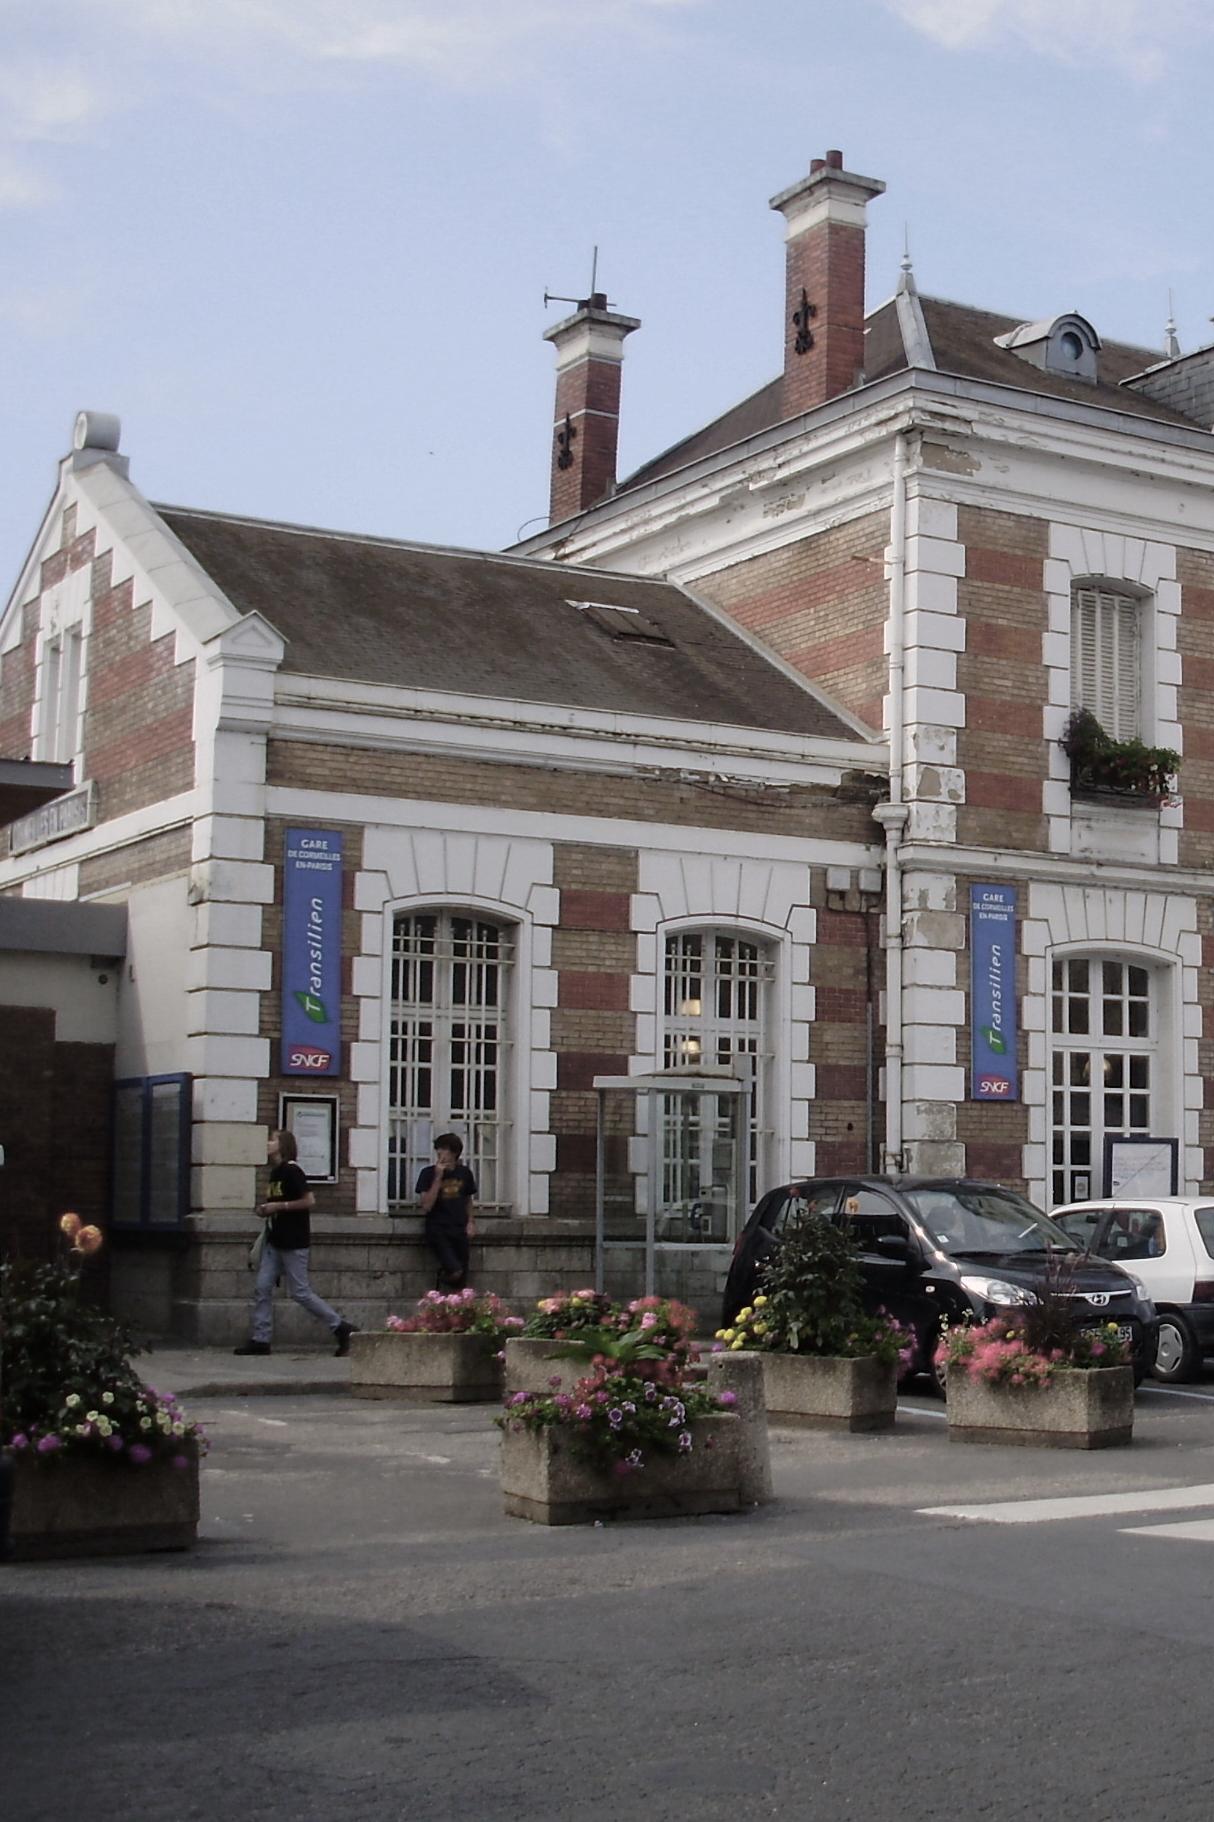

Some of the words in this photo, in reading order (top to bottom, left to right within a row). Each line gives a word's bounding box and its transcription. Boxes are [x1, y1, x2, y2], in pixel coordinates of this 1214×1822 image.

[301, 839, 329, 850] GARE
[287, 849, 298, 858] DE
[982, 893, 1004, 903] GARE
[305, 897, 324, 1012] Transilien
[989, 943, 1002, 1045] Transilien
[289, 1053, 330, 1068] SNCF
[979, 1081, 1009, 1093] SNCF
